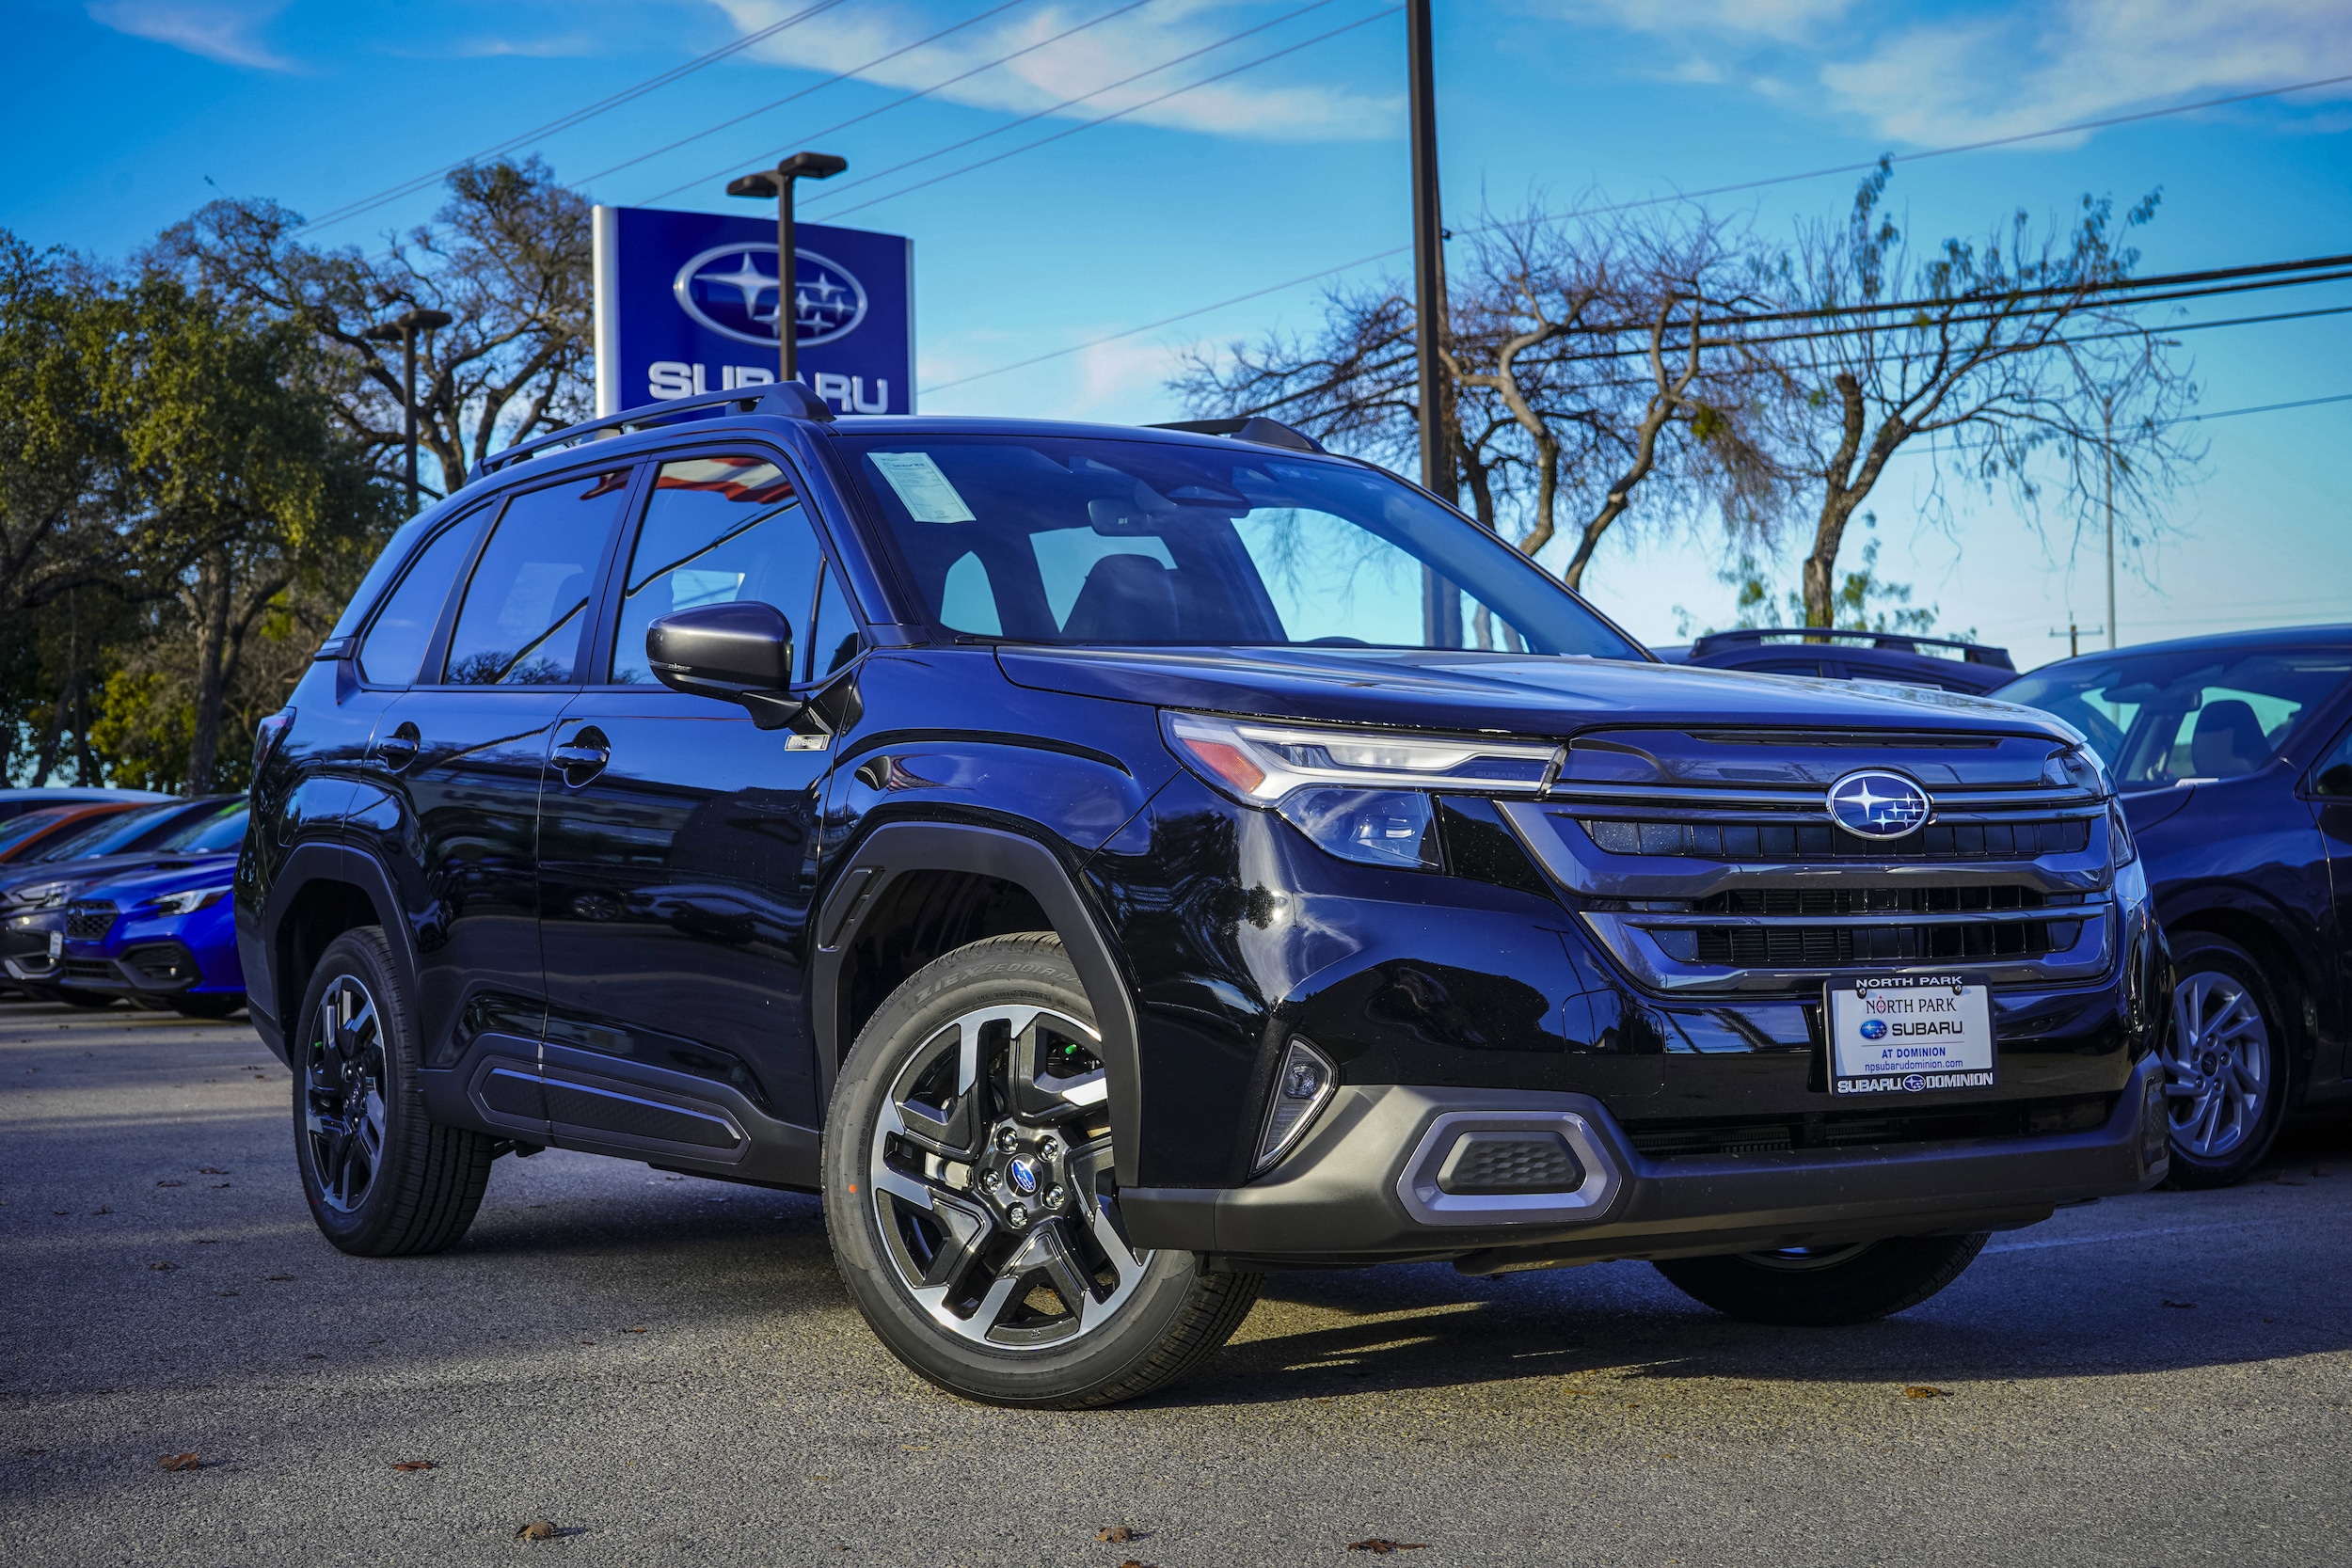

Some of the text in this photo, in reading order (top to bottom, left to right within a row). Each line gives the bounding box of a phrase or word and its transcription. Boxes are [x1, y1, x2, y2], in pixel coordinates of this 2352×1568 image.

[648, 361, 888, 414] SUBRU
[915, 966, 980, 1005] ZIEX
[1856, 975, 1963, 988] NORTH PARK
[1867, 997, 1958, 1014] NORTH PARK
[1891, 1021, 1963, 1037] SUBARU
[1882, 1047, 1946, 1059] AT DOMINION
[1864, 1059, 1963, 1073] npsubarudominion.com
[1837, 1072, 1994, 1094] SUBARU DOMINION
